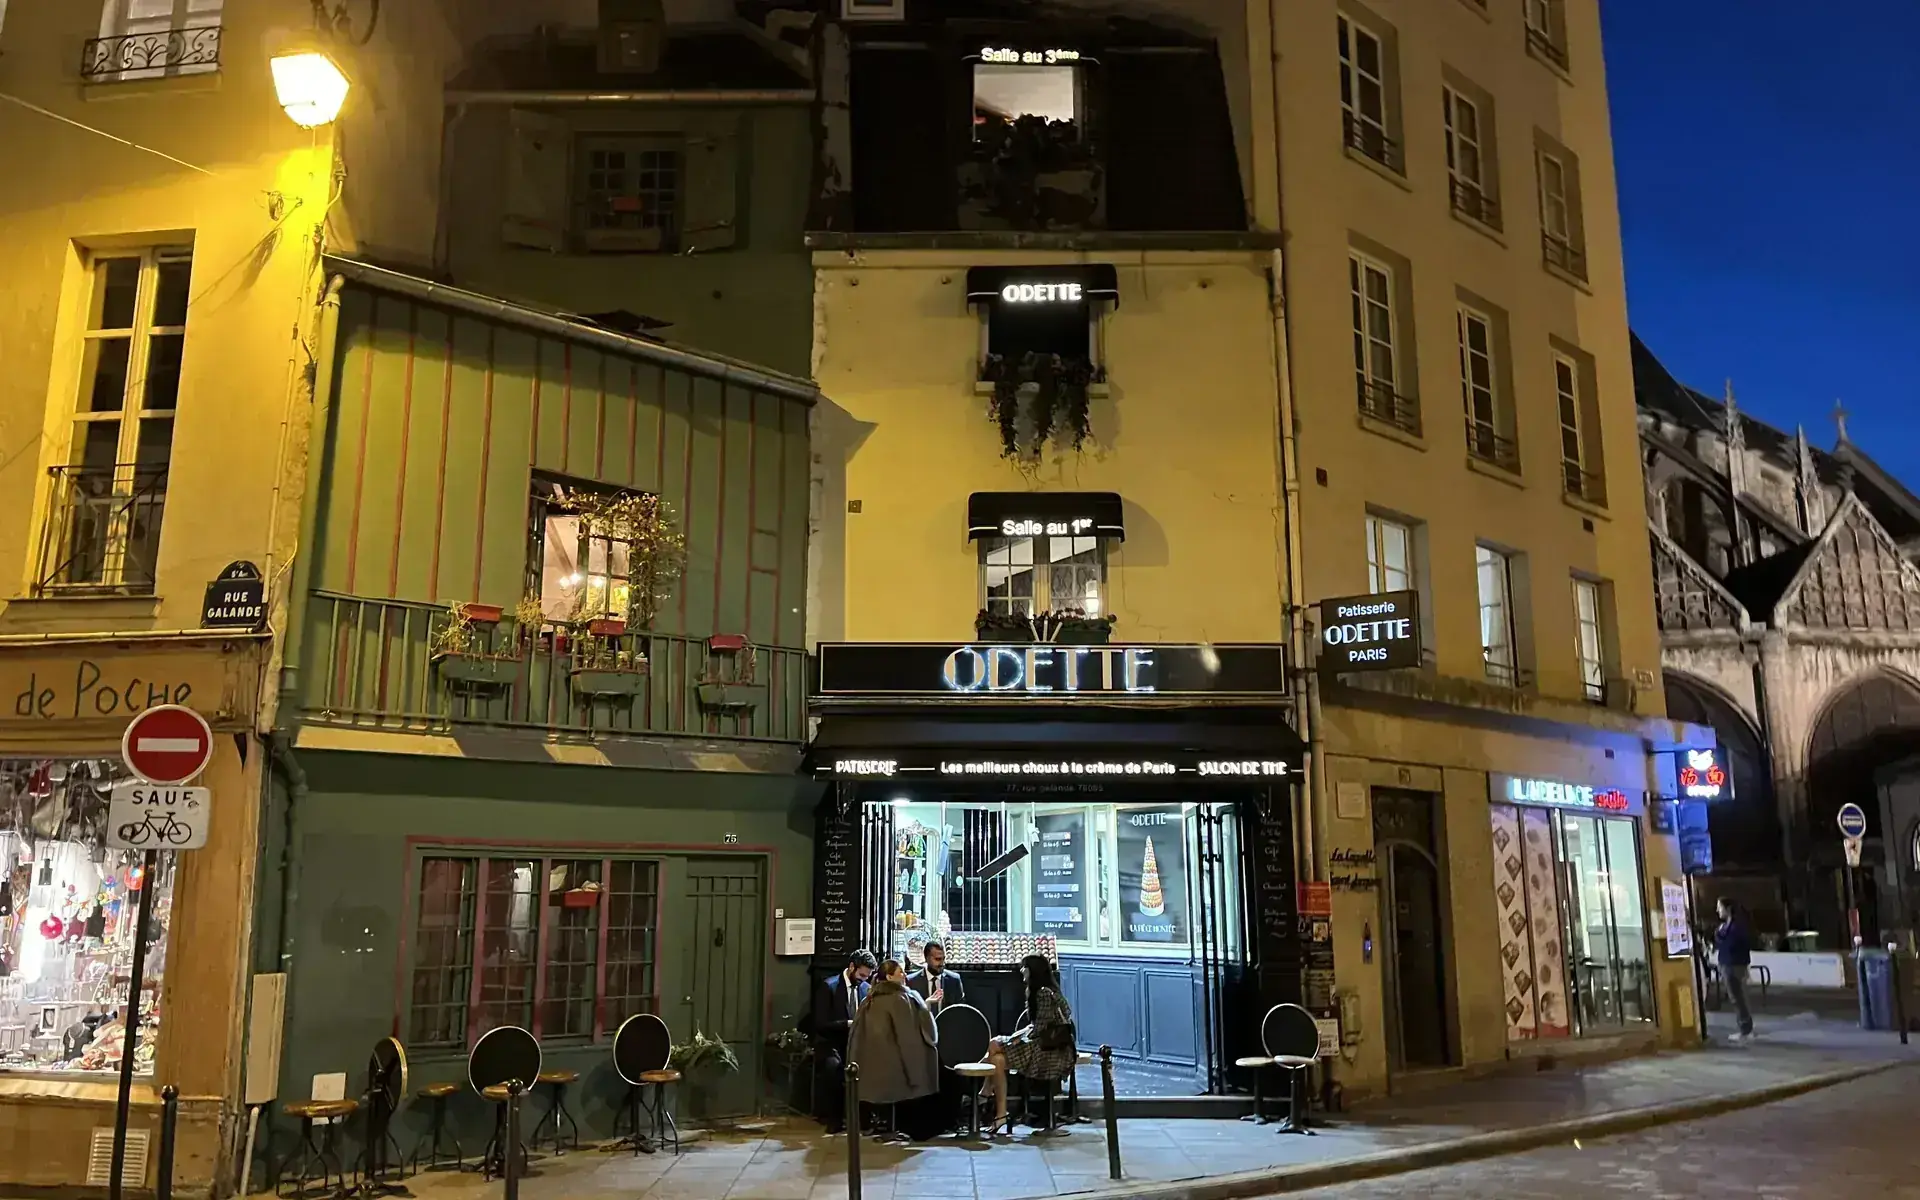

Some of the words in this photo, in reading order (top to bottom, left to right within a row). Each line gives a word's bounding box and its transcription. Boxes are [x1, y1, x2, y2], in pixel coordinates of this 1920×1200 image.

[981, 47, 1020, 63] Salle
[1022, 51, 1043, 63] au
[1002, 283, 1082, 302] ODETTE
[1002, 519, 1043, 536] Salle
[1046, 522, 1068, 535] au
[1071, 518, 1093, 535] 1er
[224, 591, 249, 603] RUE
[207, 606, 262, 619] GALANDE
[1338, 601, 1396, 618] Patisserie
[1325, 618, 1411, 645] ODETTE
[1349, 647, 1388, 662] PARIS
[943, 646, 1155, 692] ODETTE
[15, 672, 56, 719] de
[835, 760, 897, 776] PATISSERIE
[940, 761, 963, 774] Les
[965, 761, 1021, 774] meilleurs
[1022, 761, 1059, 774] choux
[1060, 762, 1070, 774] à
[1071, 762, 1084, 774] la
[1125, 762, 1142, 774] de
[1143, 761, 1176, 775] Paris
[1199, 761, 1241, 776] SALON
[1242, 762, 1260, 776] DE
[132, 790, 194, 805] SAUF
[1132, 812, 1167, 827] ODETTE
[724, 834, 738, 843] 75
